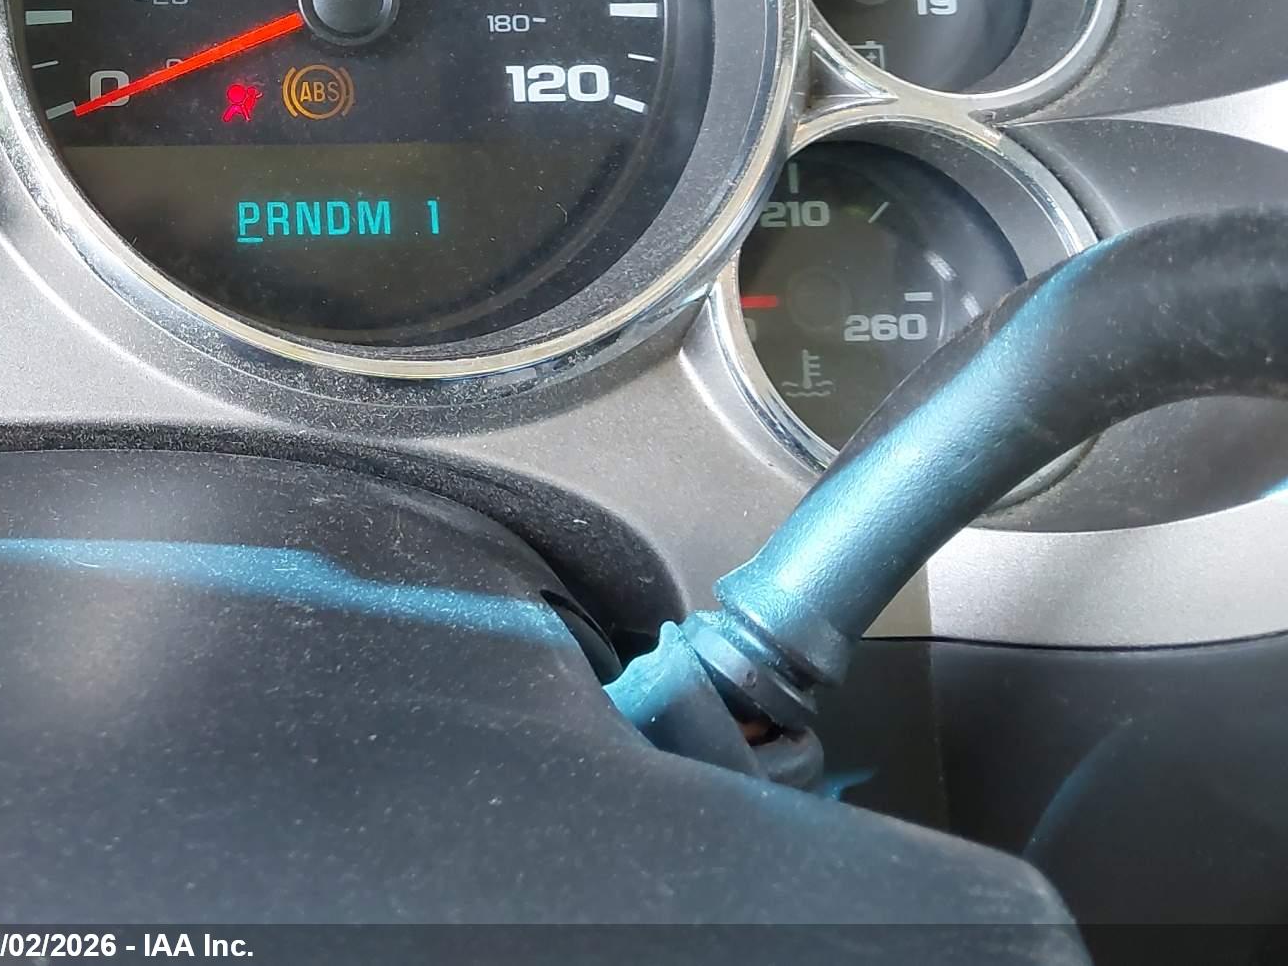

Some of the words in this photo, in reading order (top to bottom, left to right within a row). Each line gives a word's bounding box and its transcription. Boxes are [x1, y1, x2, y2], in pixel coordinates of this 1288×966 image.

[486, 14, 531, 33] 180
[89, 69, 131, 108] 0
[299, 80, 341, 103] ABS
[505, 63, 610, 103] 120
[237, 199, 392, 243] PRNDM
[759, 200, 831, 228] 210
[843, 313, 929, 342] 260
